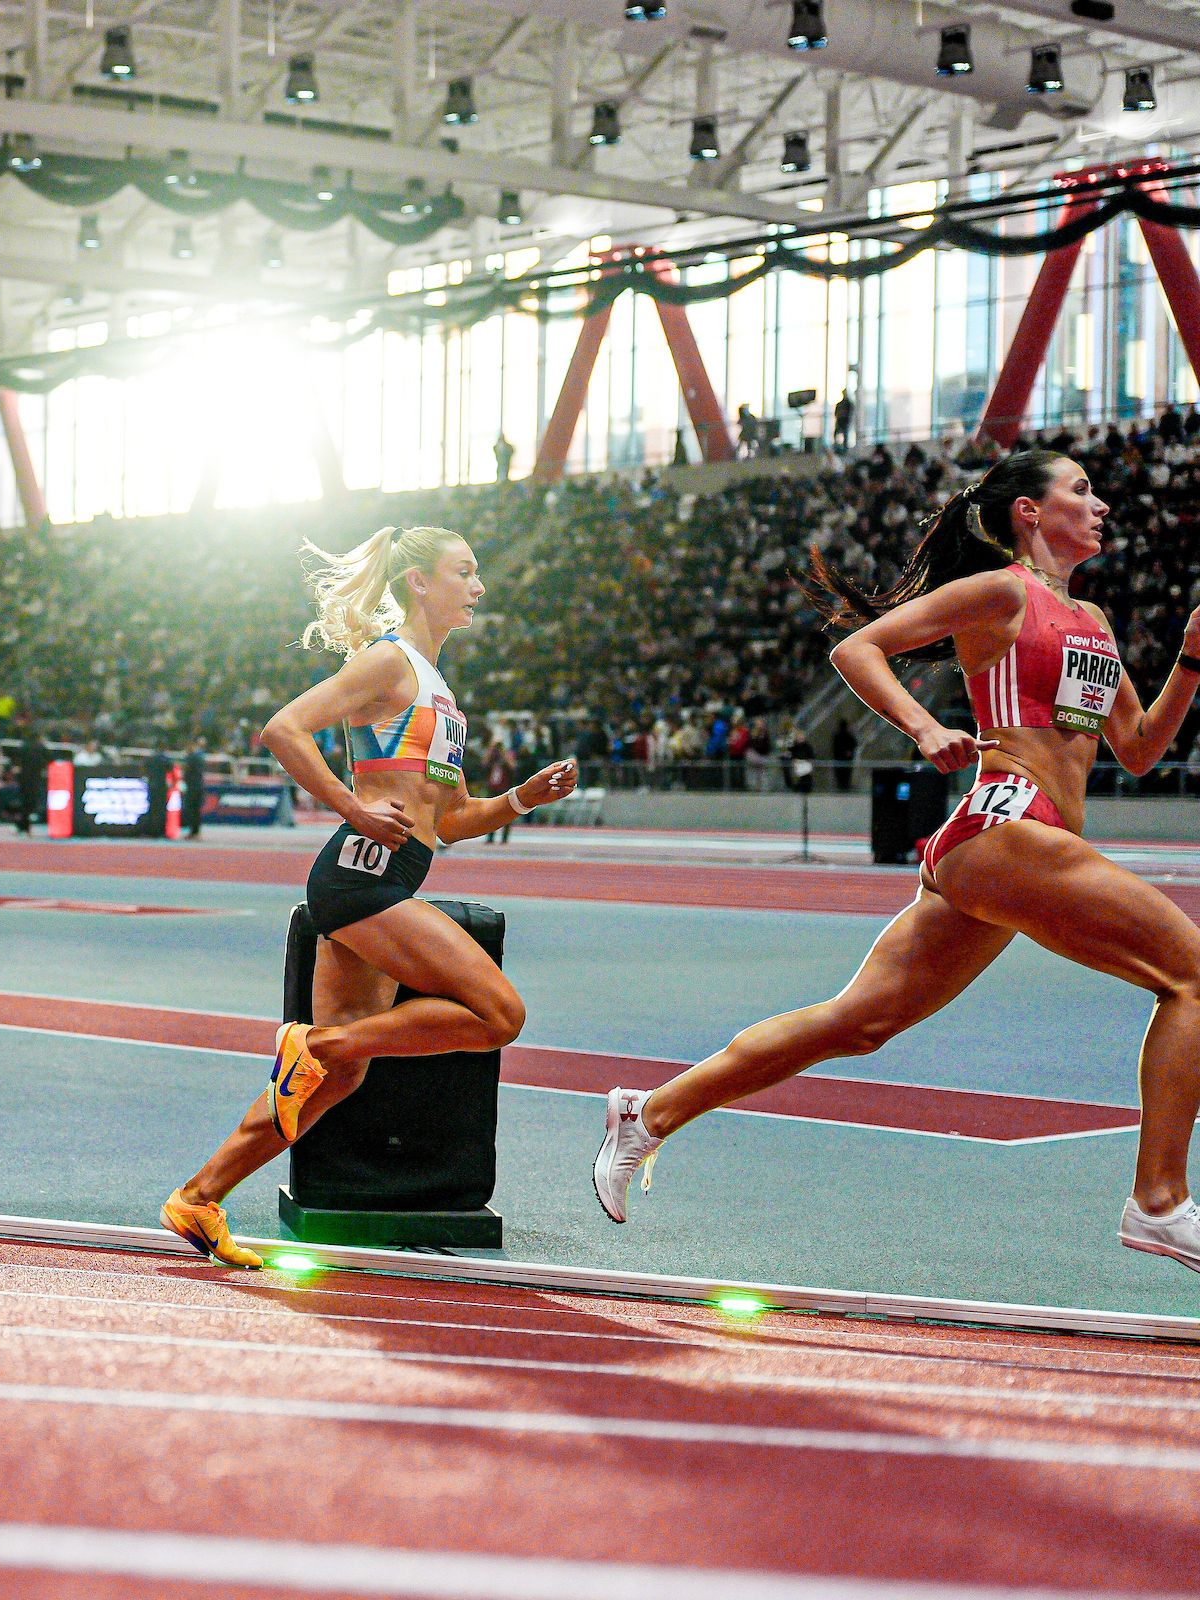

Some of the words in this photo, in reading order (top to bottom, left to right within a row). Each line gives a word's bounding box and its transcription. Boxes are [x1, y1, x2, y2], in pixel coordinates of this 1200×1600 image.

[1065, 634, 1090, 647] new
[1092, 636, 1119, 656] balan
[1066, 650, 1120, 690] PARKER
[1057, 711, 1089, 727] BOSTON
[429, 765, 459, 783] BOSTON
[980, 784, 1019, 816] 12
[352, 837, 382, 870] 10
